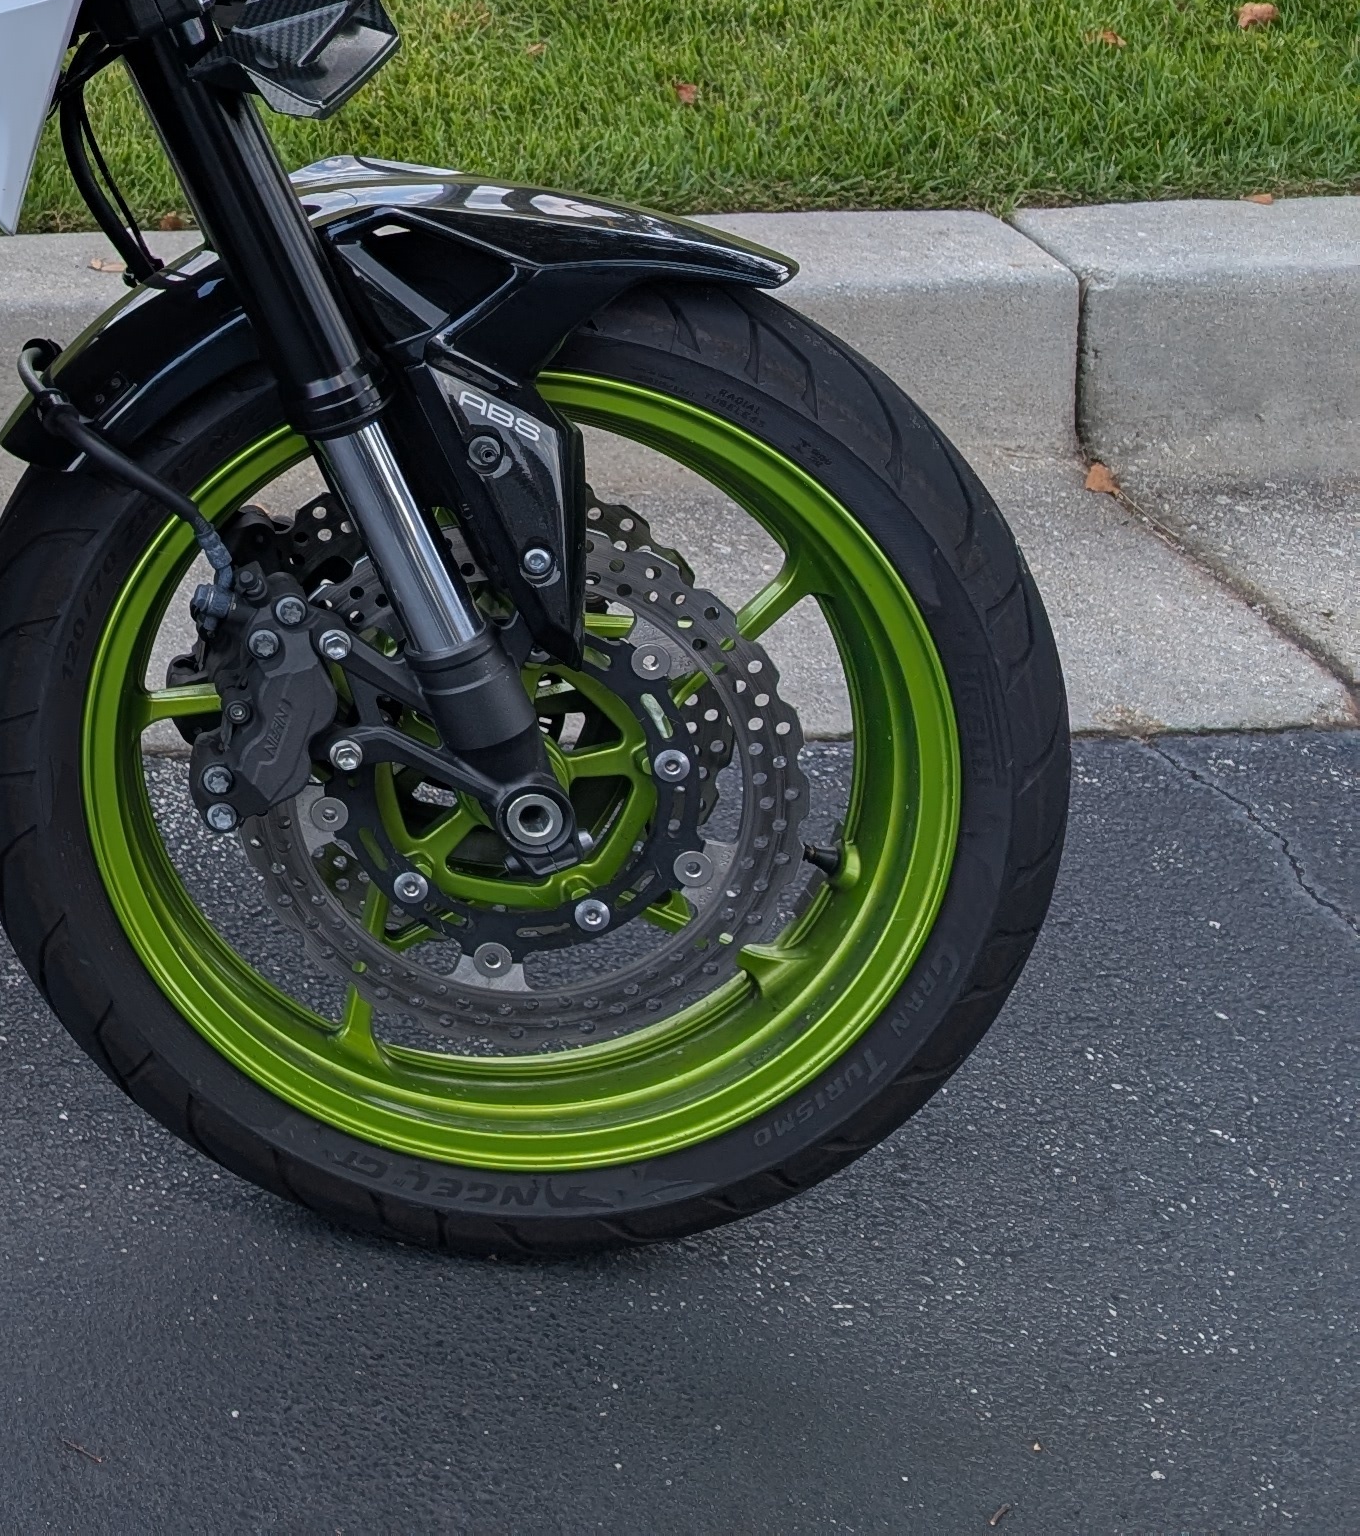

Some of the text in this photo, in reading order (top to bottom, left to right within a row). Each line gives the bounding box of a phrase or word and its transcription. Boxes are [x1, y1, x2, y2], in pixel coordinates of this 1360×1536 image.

[458, 391, 541, 441] ABS
[753, 943, 961, 1148] GRAN TURISMO
